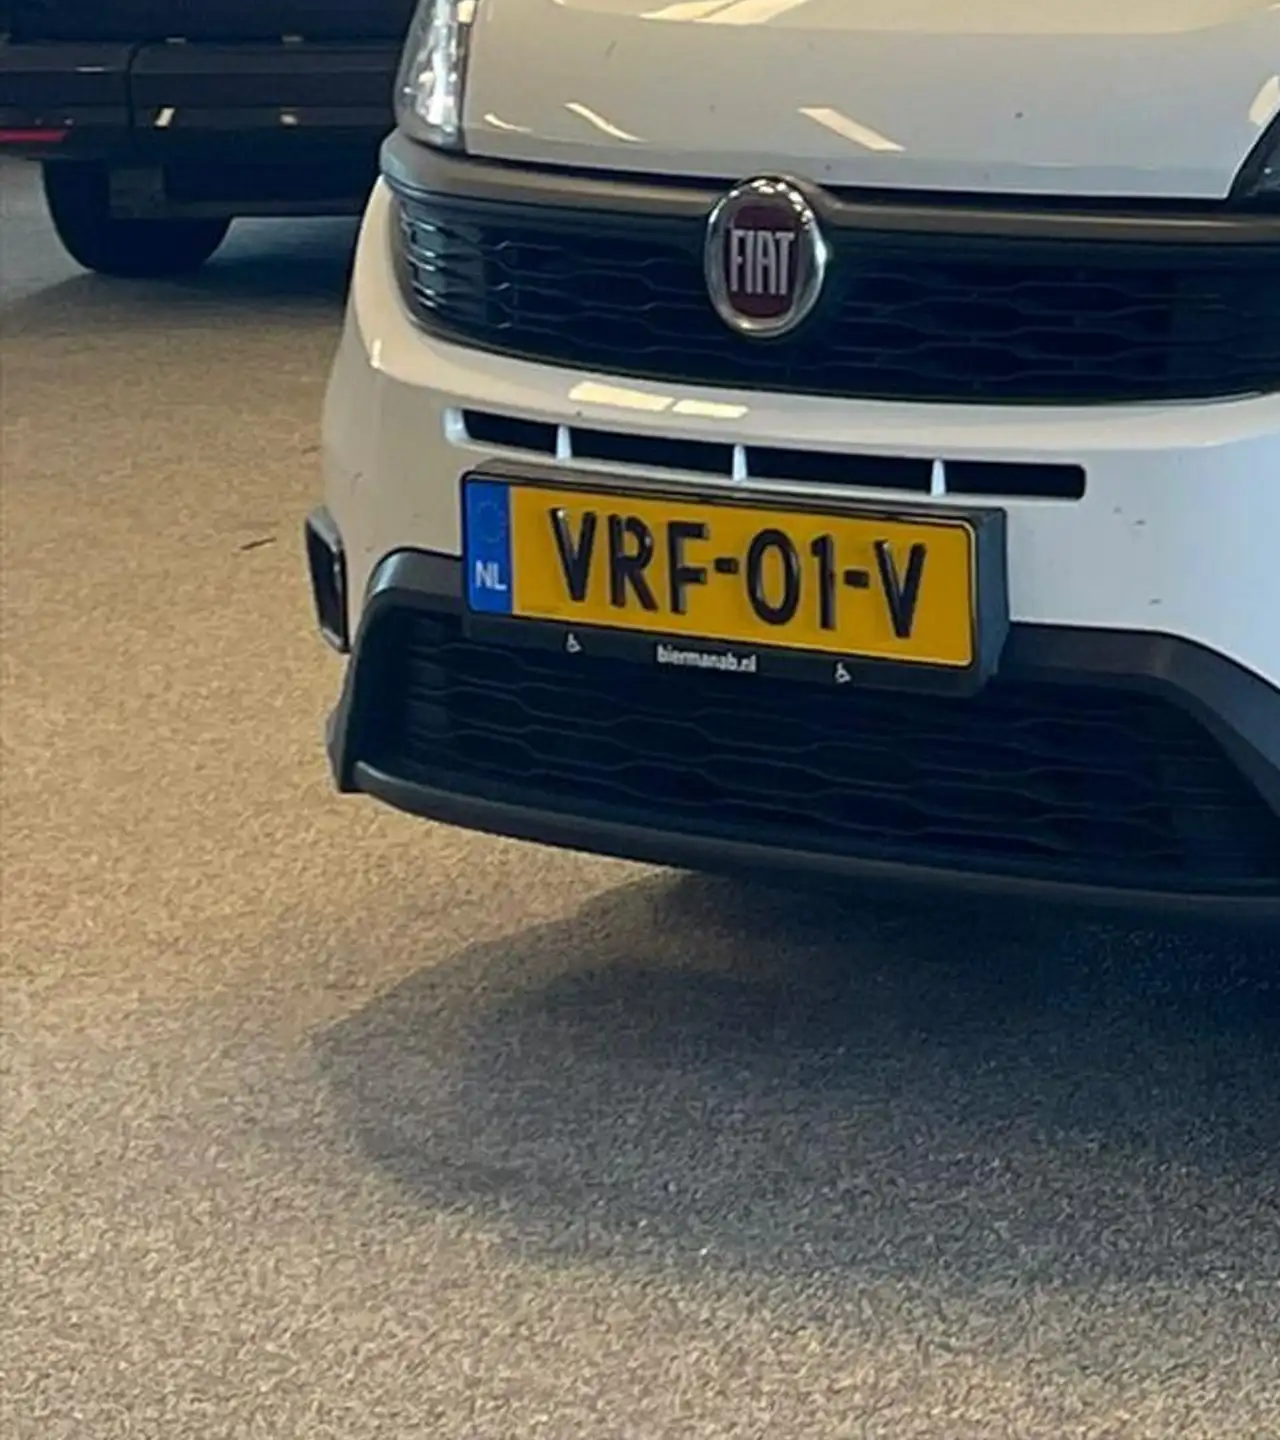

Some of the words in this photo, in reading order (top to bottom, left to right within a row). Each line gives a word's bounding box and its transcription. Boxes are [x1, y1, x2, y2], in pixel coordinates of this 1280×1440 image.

[729, 229, 795, 296] FIAT
[474, 560, 507, 593] NL
[549, 507, 928, 639] VRF-01-V
[656, 644, 757, 673] biermanab.nl
